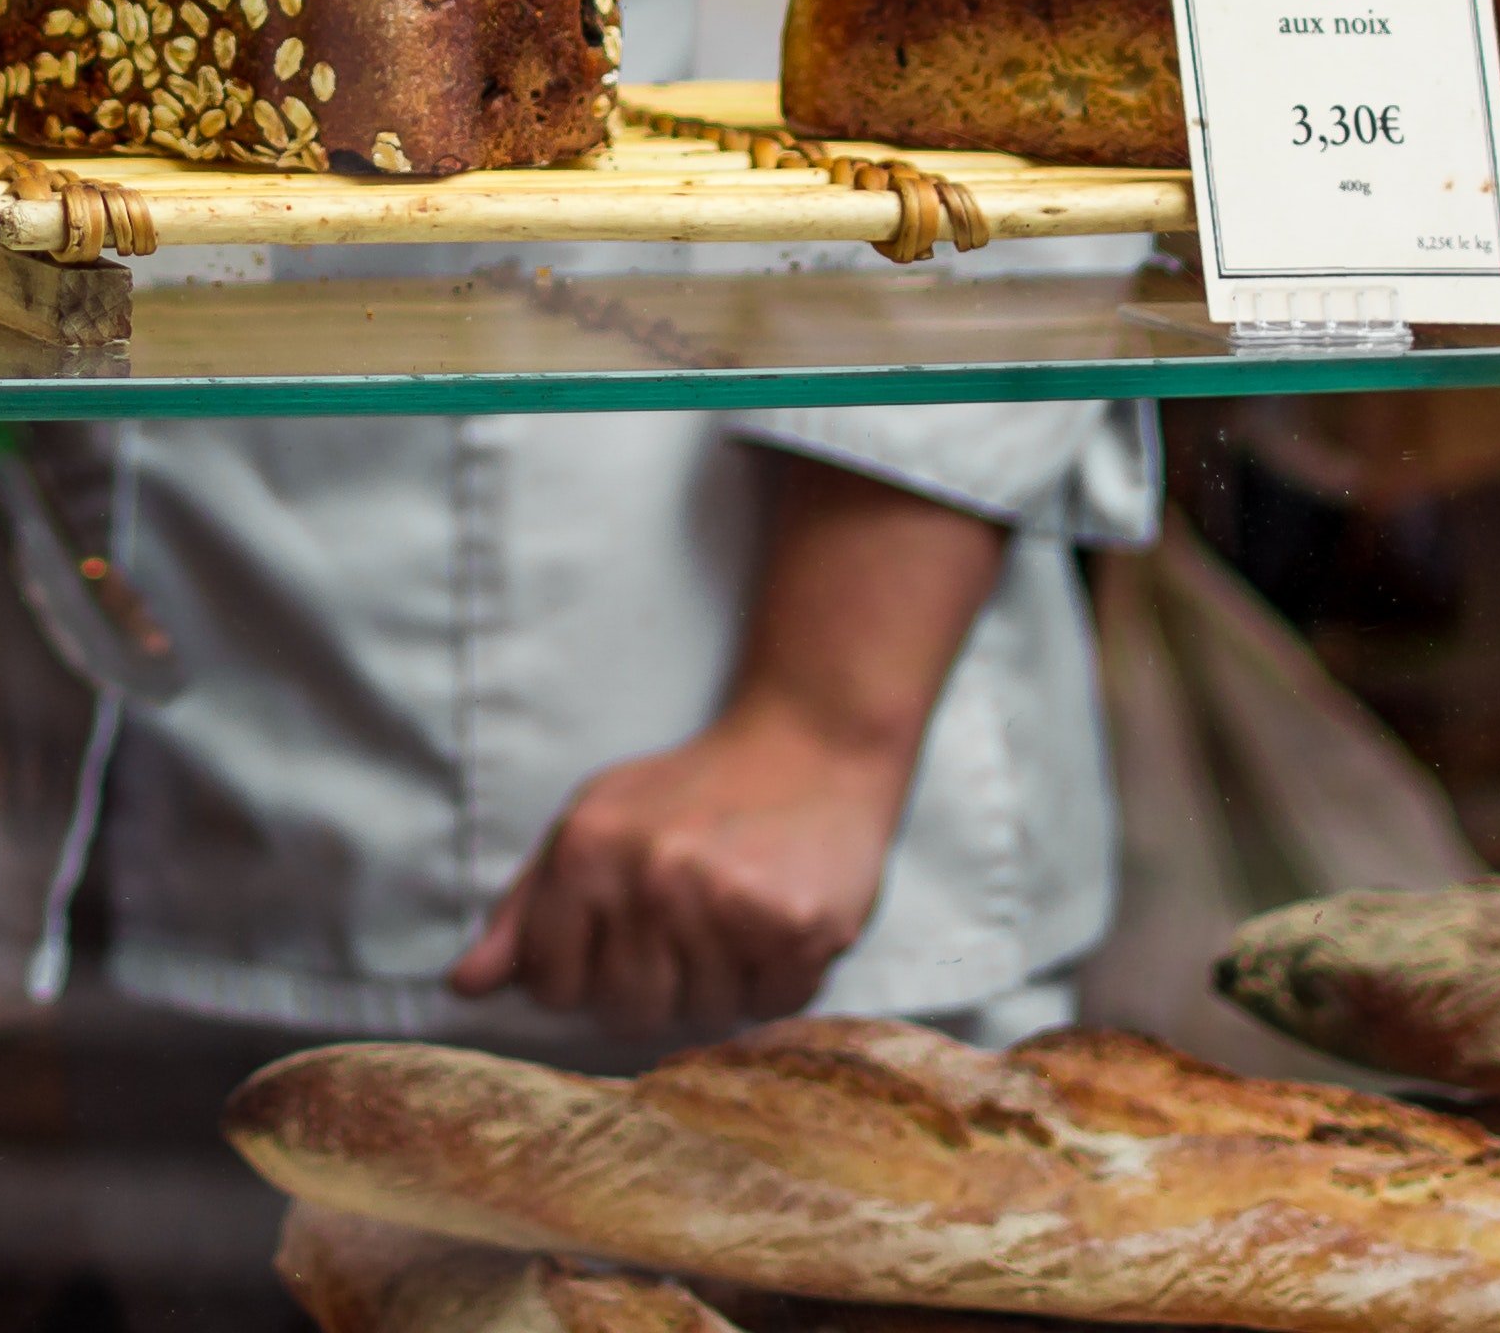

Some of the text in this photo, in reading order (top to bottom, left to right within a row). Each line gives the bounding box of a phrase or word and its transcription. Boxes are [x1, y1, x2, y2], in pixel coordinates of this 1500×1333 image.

[1279, 9, 1391, 34] aux noix
[1291, 104, 1405, 153] 3,30€
[1339, 180, 1372, 196] 400g
[1475, 234, 1492, 255] kg
